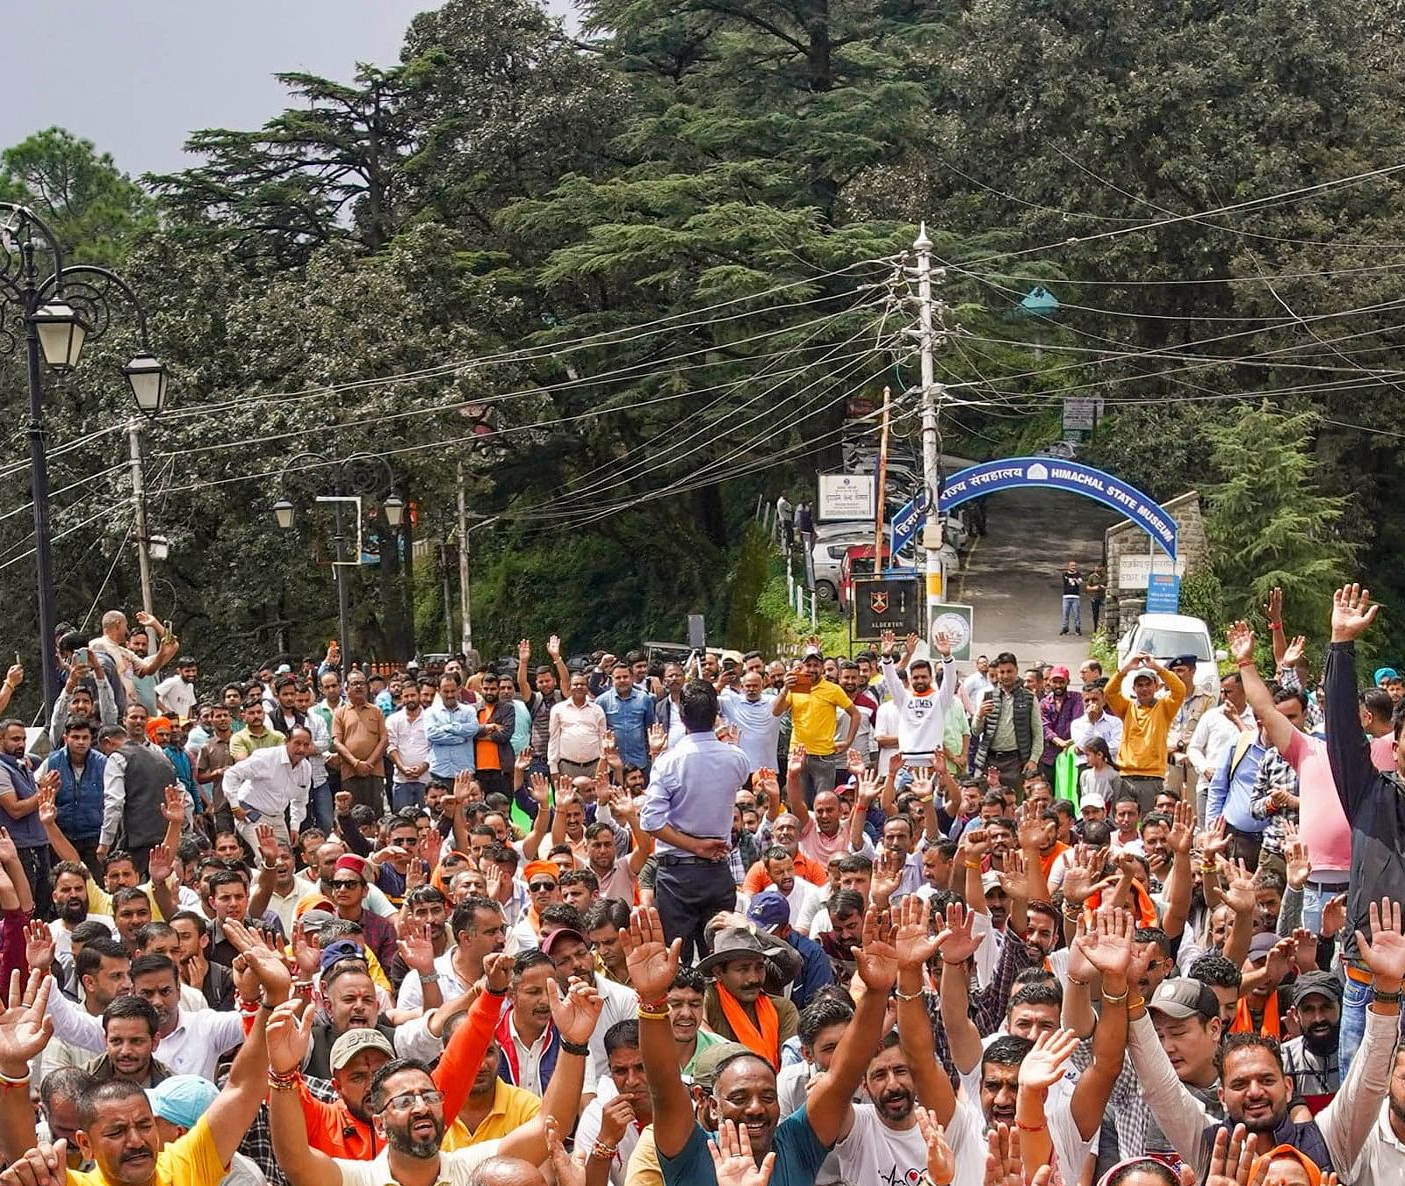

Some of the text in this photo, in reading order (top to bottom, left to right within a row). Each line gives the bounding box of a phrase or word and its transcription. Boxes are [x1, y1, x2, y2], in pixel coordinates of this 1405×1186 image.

[968, 468, 1024, 487] संग्रहालय
[1051, 468, 1175, 543] HIMACHAL STATE MUSEUM
